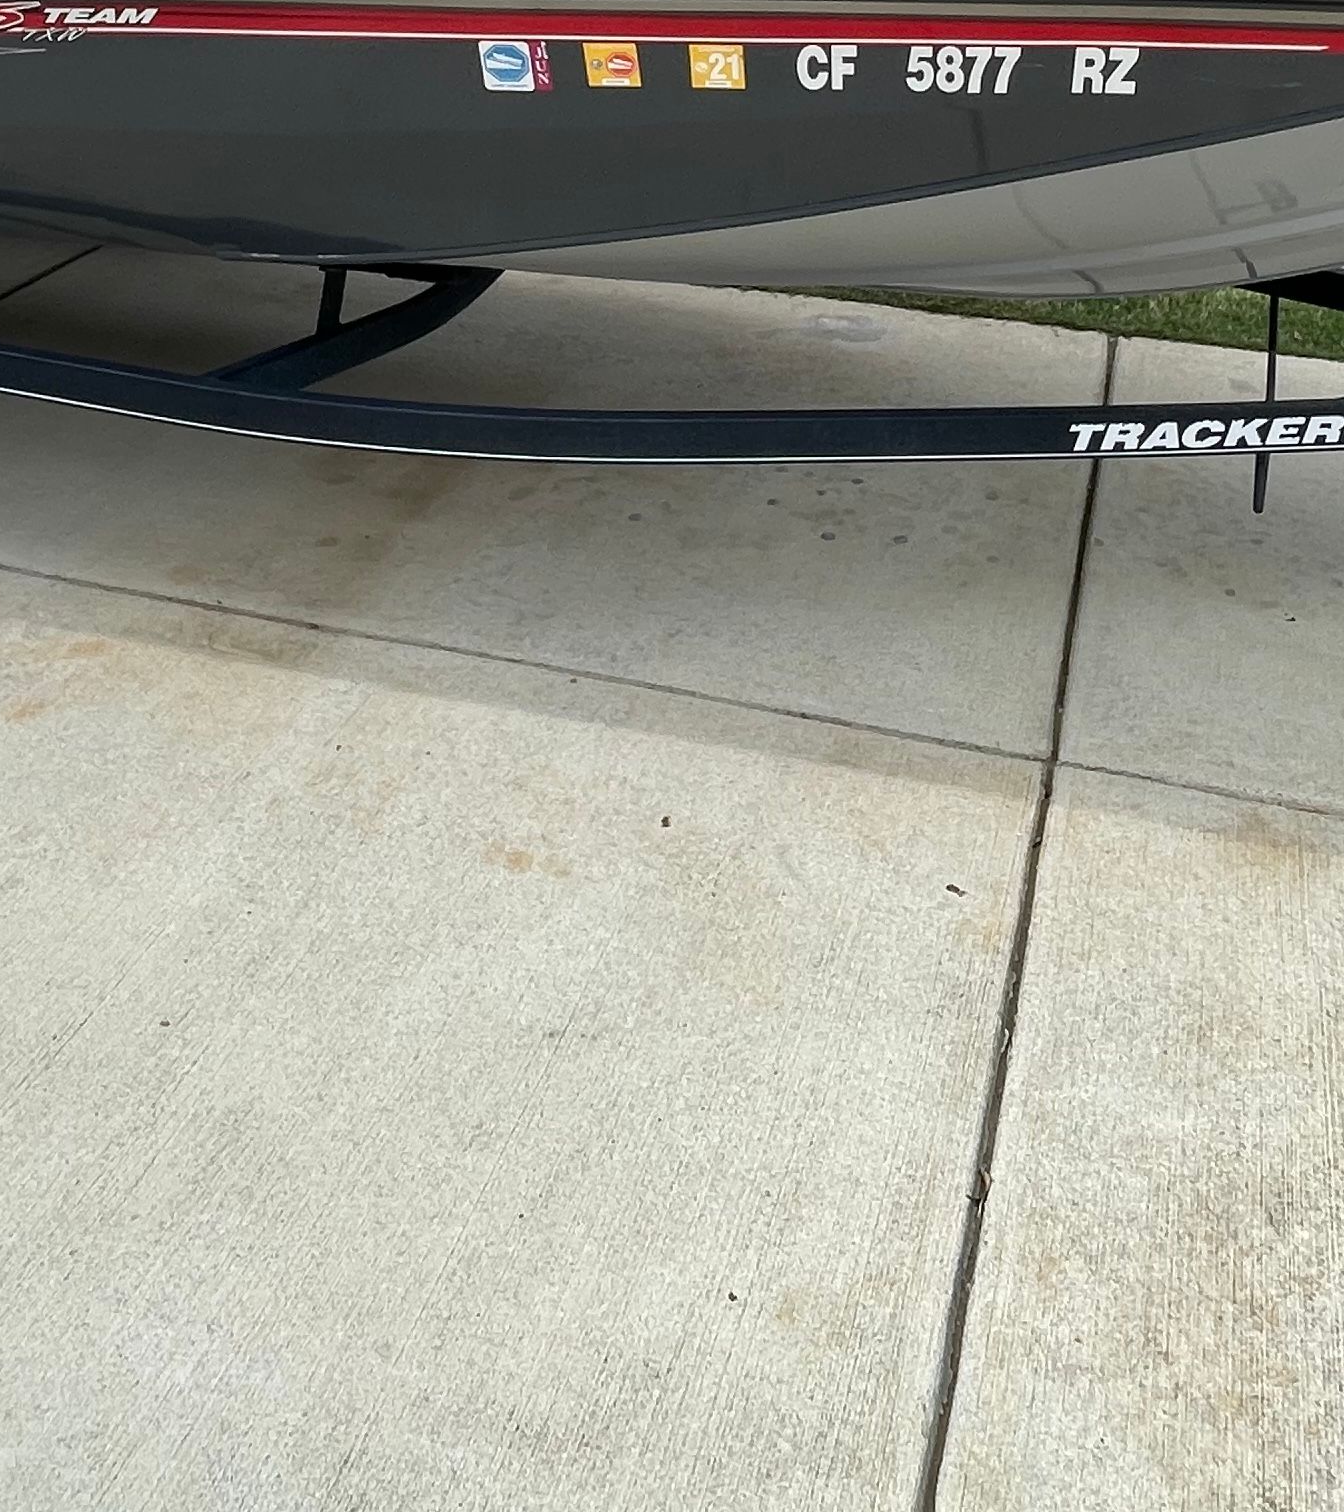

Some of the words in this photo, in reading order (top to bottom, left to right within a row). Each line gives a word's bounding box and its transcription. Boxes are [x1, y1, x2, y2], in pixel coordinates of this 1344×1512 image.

[43, 7, 159, 25] TEAM
[22, 27, 88, 43] TXW
[708, 52, 741, 81] 21
[796, 44, 858, 91] CF
[905, 46, 1022, 94] 5877
[1070, 47, 1140, 95] RZ
